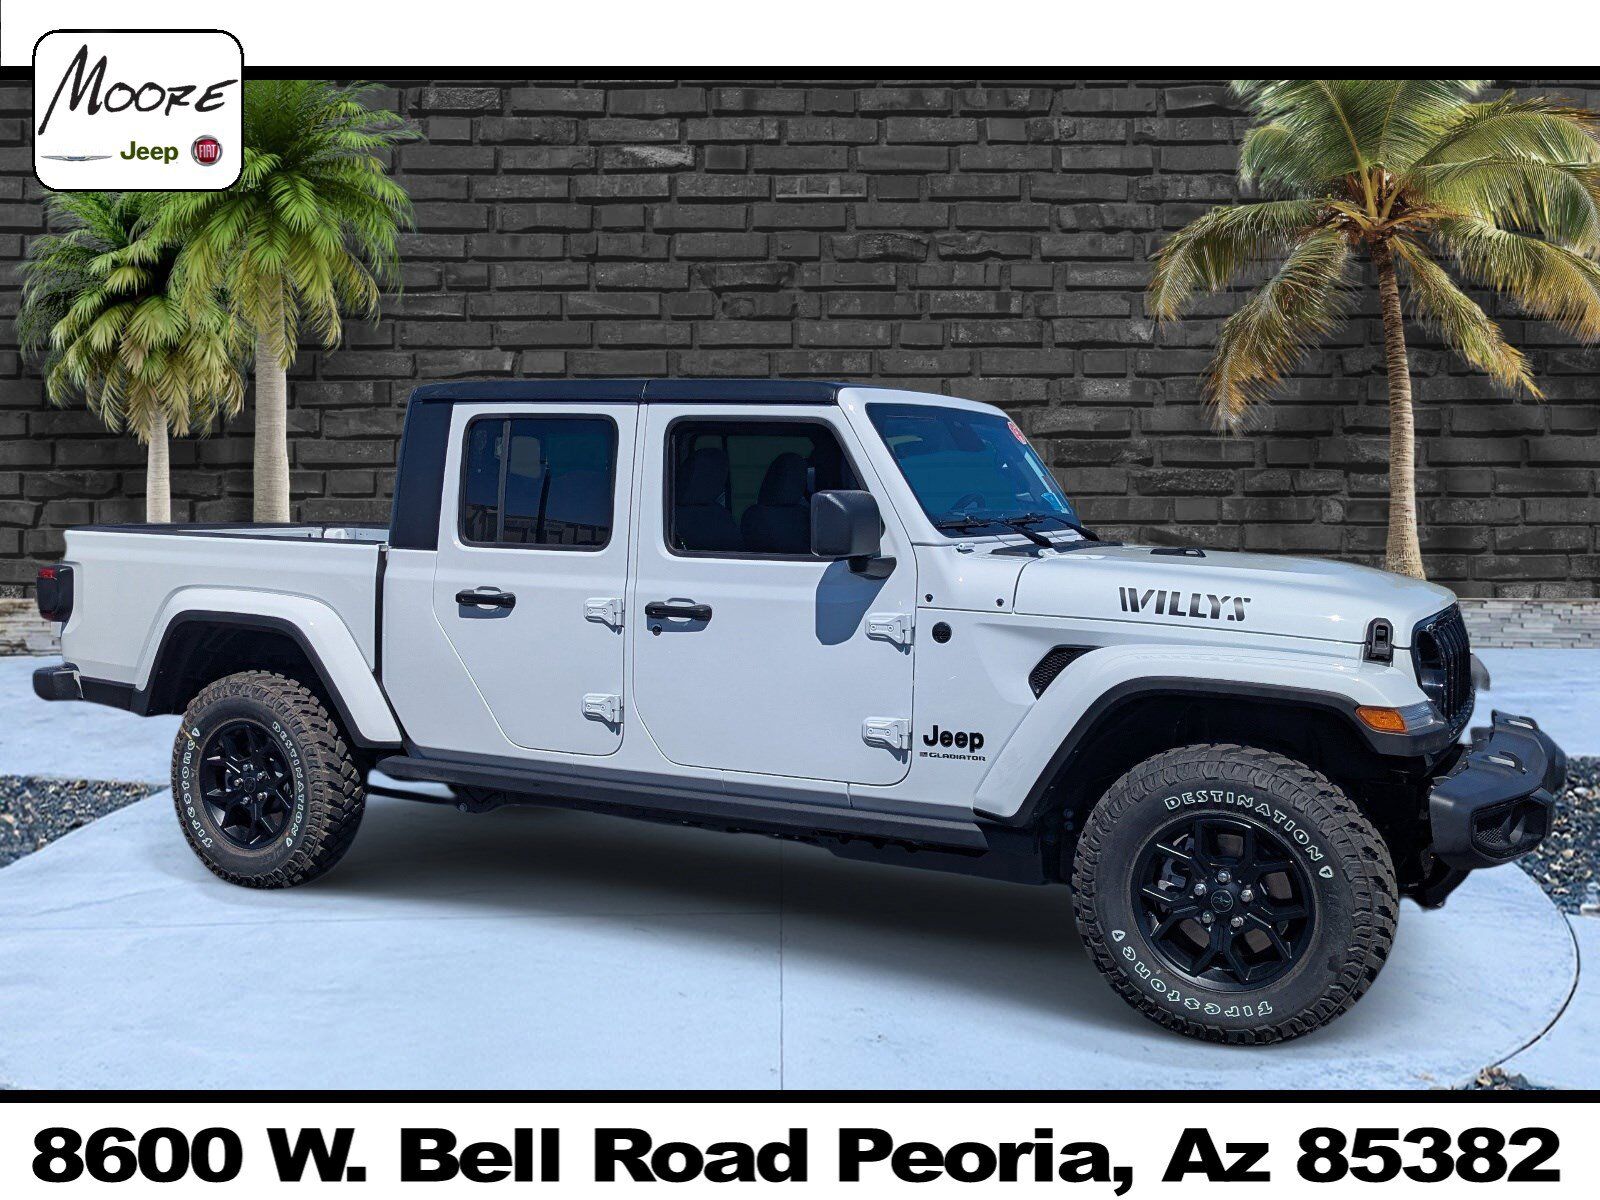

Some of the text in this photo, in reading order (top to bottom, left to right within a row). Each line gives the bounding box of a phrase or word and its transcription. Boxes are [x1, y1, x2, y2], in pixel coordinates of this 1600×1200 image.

[1118, 587, 1252, 622] WILLYS
[922, 724, 985, 753] Jeep
[928, 752, 986, 762] GLADIATOR
[272, 721, 305, 837] DESTINATION
[1164, 790, 1323, 862] DESTINATION
